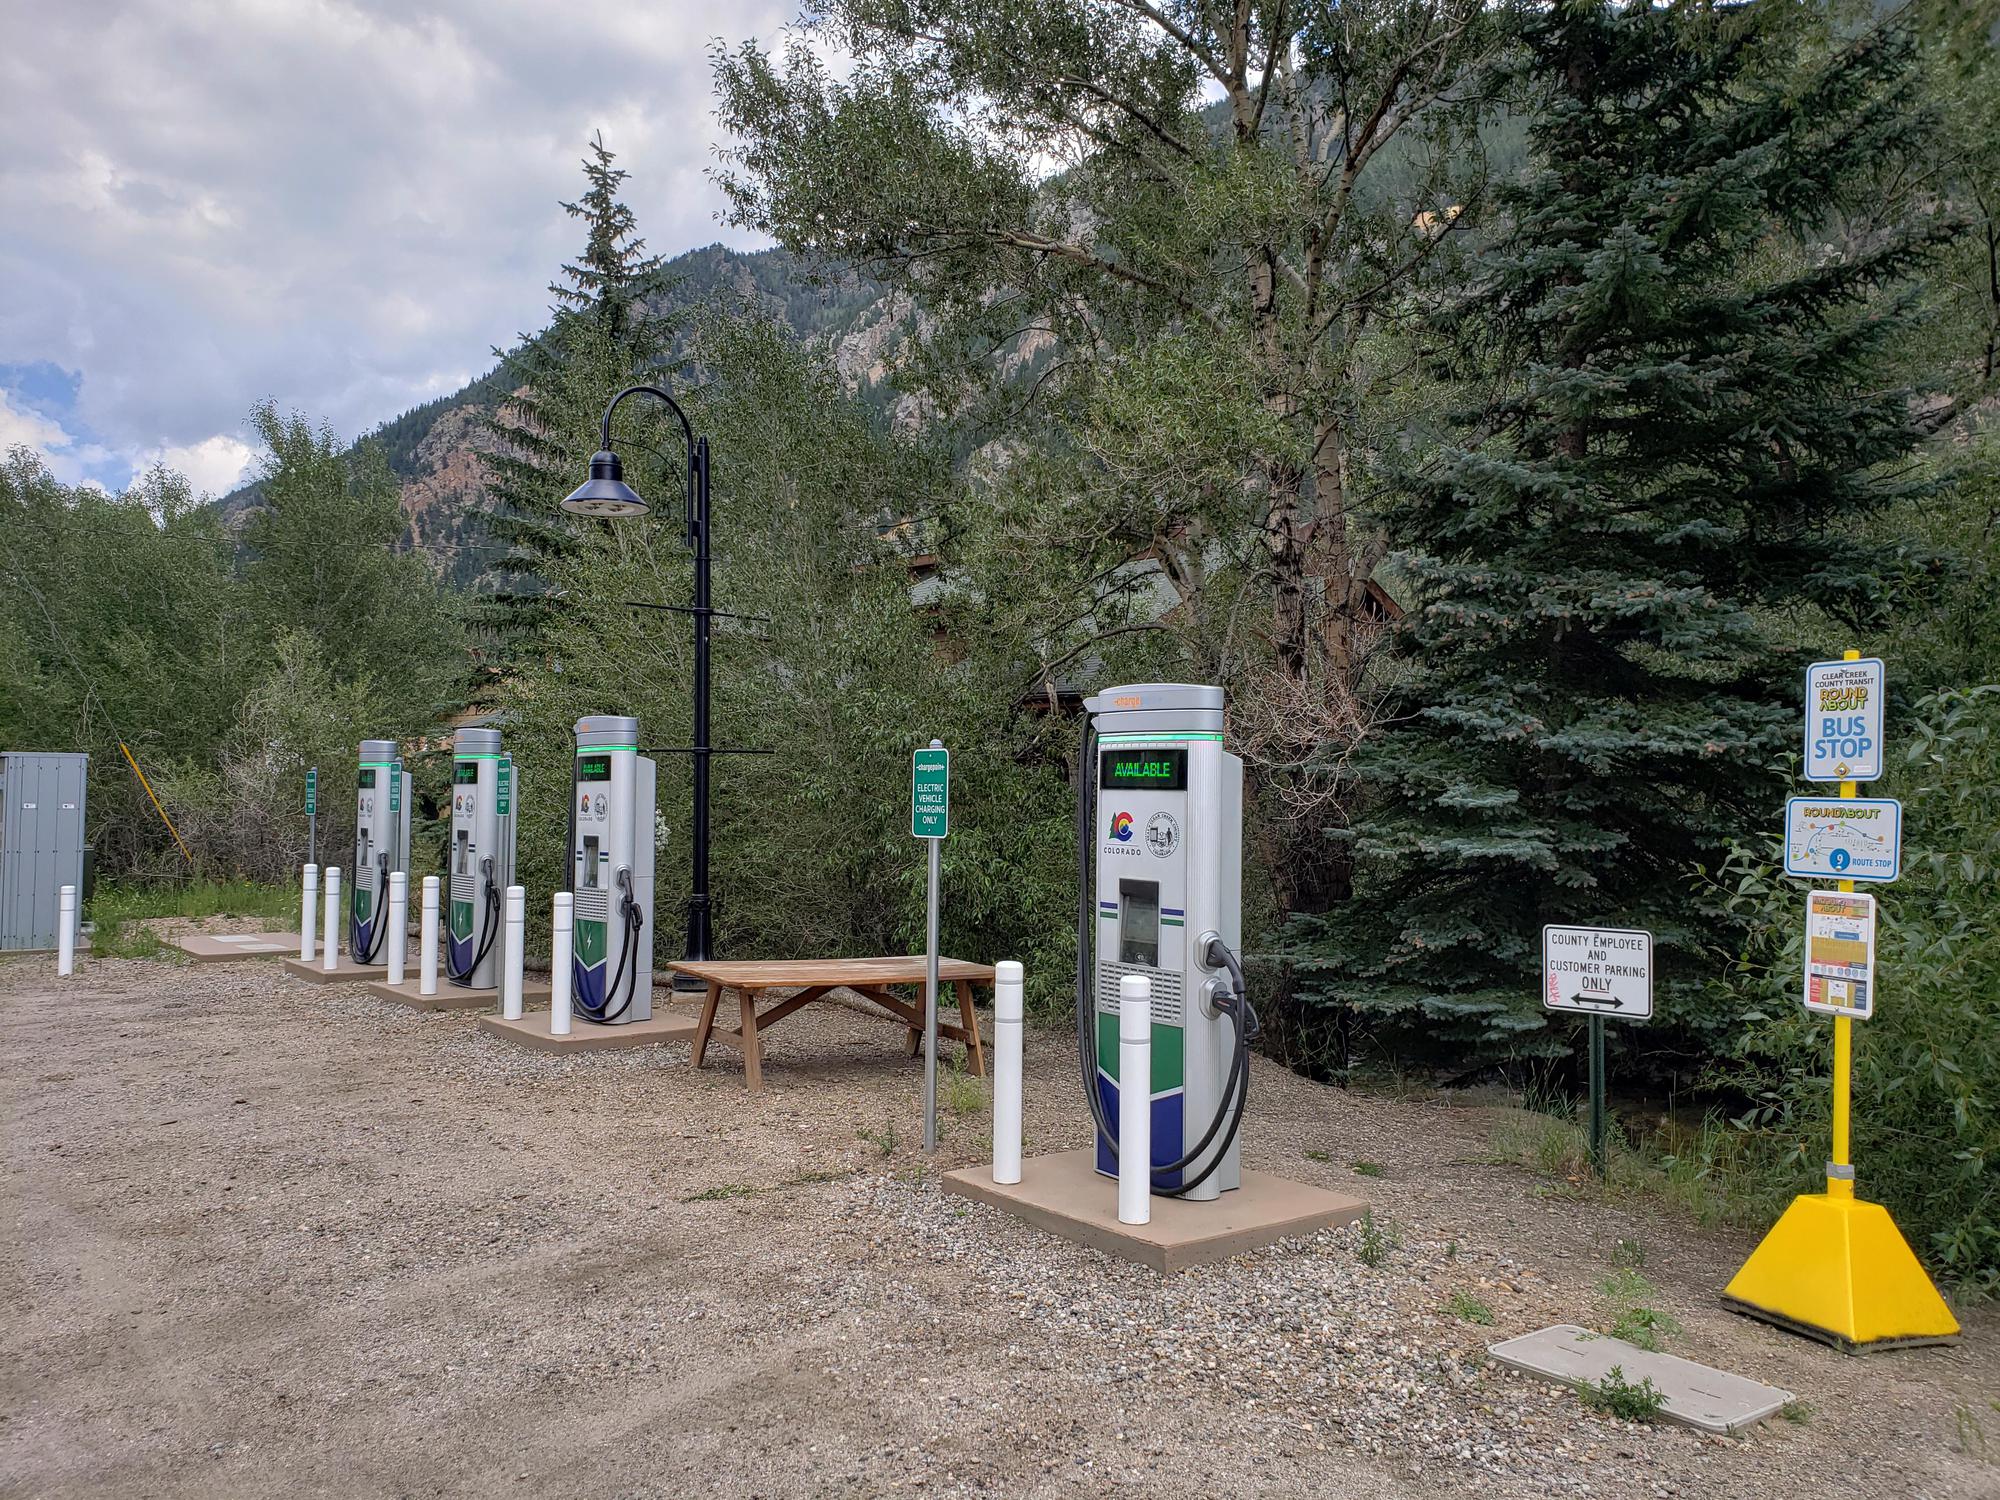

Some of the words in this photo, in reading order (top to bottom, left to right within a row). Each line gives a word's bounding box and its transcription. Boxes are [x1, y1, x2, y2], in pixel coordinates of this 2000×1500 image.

[1822, 672, 1844, 681] CLEAR
[1845, 670, 1868, 679] CREEK
[1815, 679, 1843, 688] COUNTY
[1845, 677, 1874, 686] TRANSIT
[1819, 686, 1868, 701] ROUND
[1819, 698, 1868, 712] ABOUT
[1822, 716, 1866, 738] BUS
[1814, 737, 1872, 759] STOP
[1114, 762, 1170, 778] AVAILABLE
[917, 784, 944, 792] ELECTRIC
[918, 795, 942, 803] VEHICLE
[915, 805, 945, 814] CHARGING
[1803, 807, 1881, 820] ROUNDABOUT
[922, 816, 938, 824] ONLY
[1103, 847, 1141, 856] COLORADO
[1836, 854, 1844, 865] 9
[1852, 858, 1873, 867] ROUTE
[1874, 858, 1892, 868] STOP
[1551, 933, 1589, 946] COUNTY
[1593, 937, 1643, 950] EMPLOYEE
[1587, 950, 1607, 961] AND
[1550, 960, 1600, 975] CUSTOMER
[1604, 964, 1646, 978] PARKING
[1582, 976, 1612, 991] ONLY
